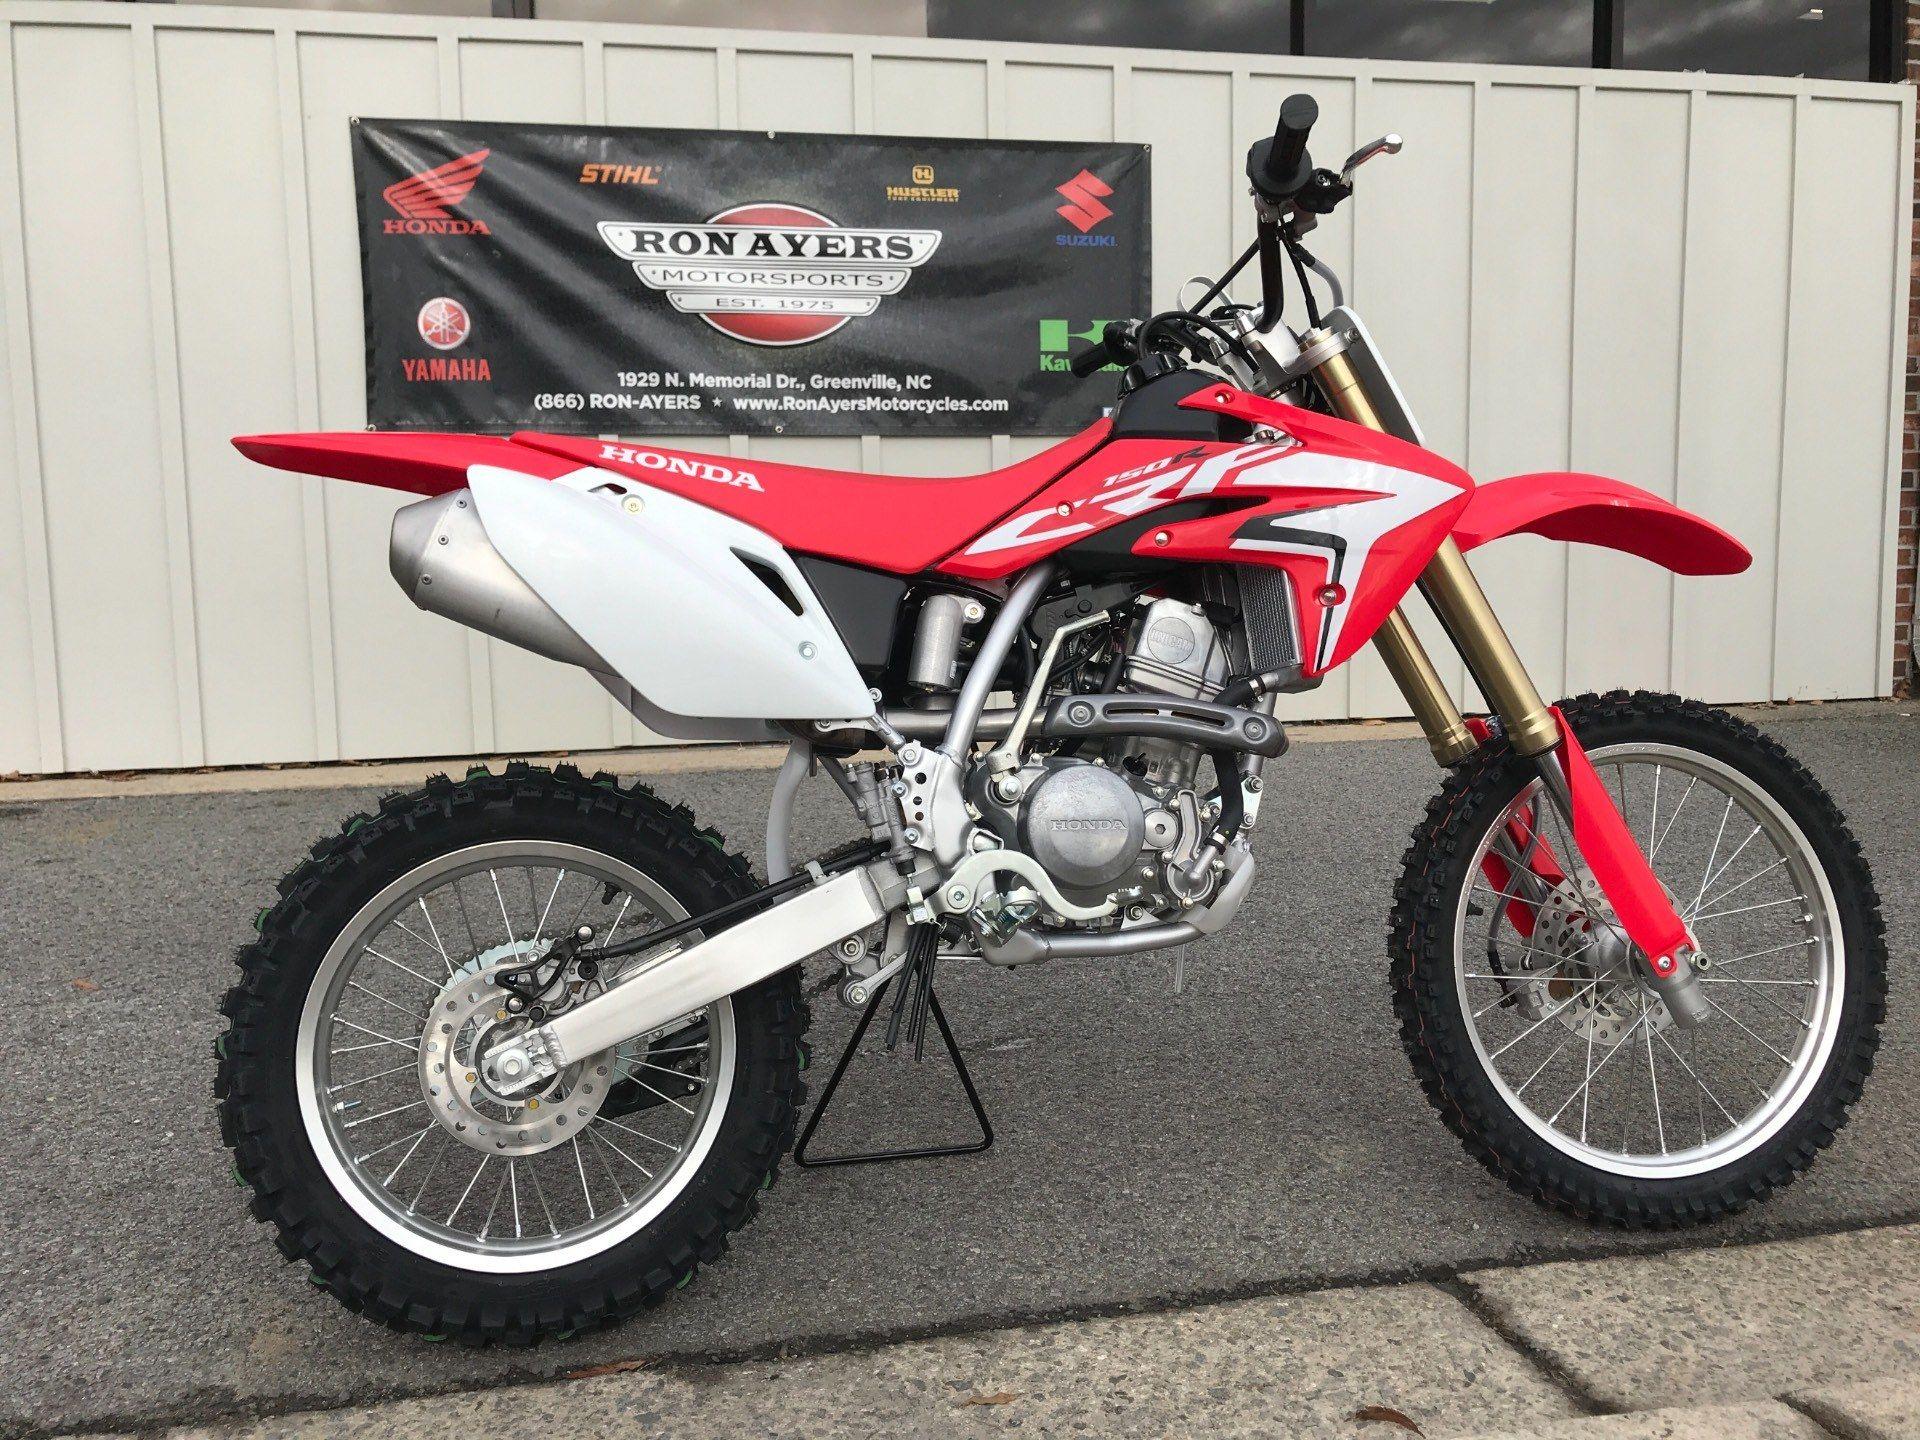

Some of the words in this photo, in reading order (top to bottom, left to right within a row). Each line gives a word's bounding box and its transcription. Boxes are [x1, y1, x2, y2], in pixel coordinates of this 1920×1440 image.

[579, 163, 659, 184] STIHL
[886, 187, 959, 198] HUSTLER
[383, 219, 491, 235] HONDA
[630, 230, 738, 256] RON
[746, 232, 913, 260] AYERS
[1056, 234, 1116, 247] SUZUKI
[663, 269, 883, 287] MOTORSPORTS
[716, 298, 765, 308] EST.
[777, 299, 834, 310] 1975
[402, 358, 491, 381] YAMAHA
[617, 371, 661, 388] 1929
[665, 372, 685, 388] N.
[689, 373, 771, 389] Memorial
[776, 374, 806, 392] Dr.,
[810, 374, 902, 392] Greenville,
[905, 374, 933, 390] NC
[534, 393, 585, 411] (866)
[589, 393, 702, 410] RON-AYERS
[732, 396, 1009, 414] www.RonAyersMotorcycles.com
[599, 444, 765, 493] HONDA
[1050, 819, 1128, 831] HONDA
